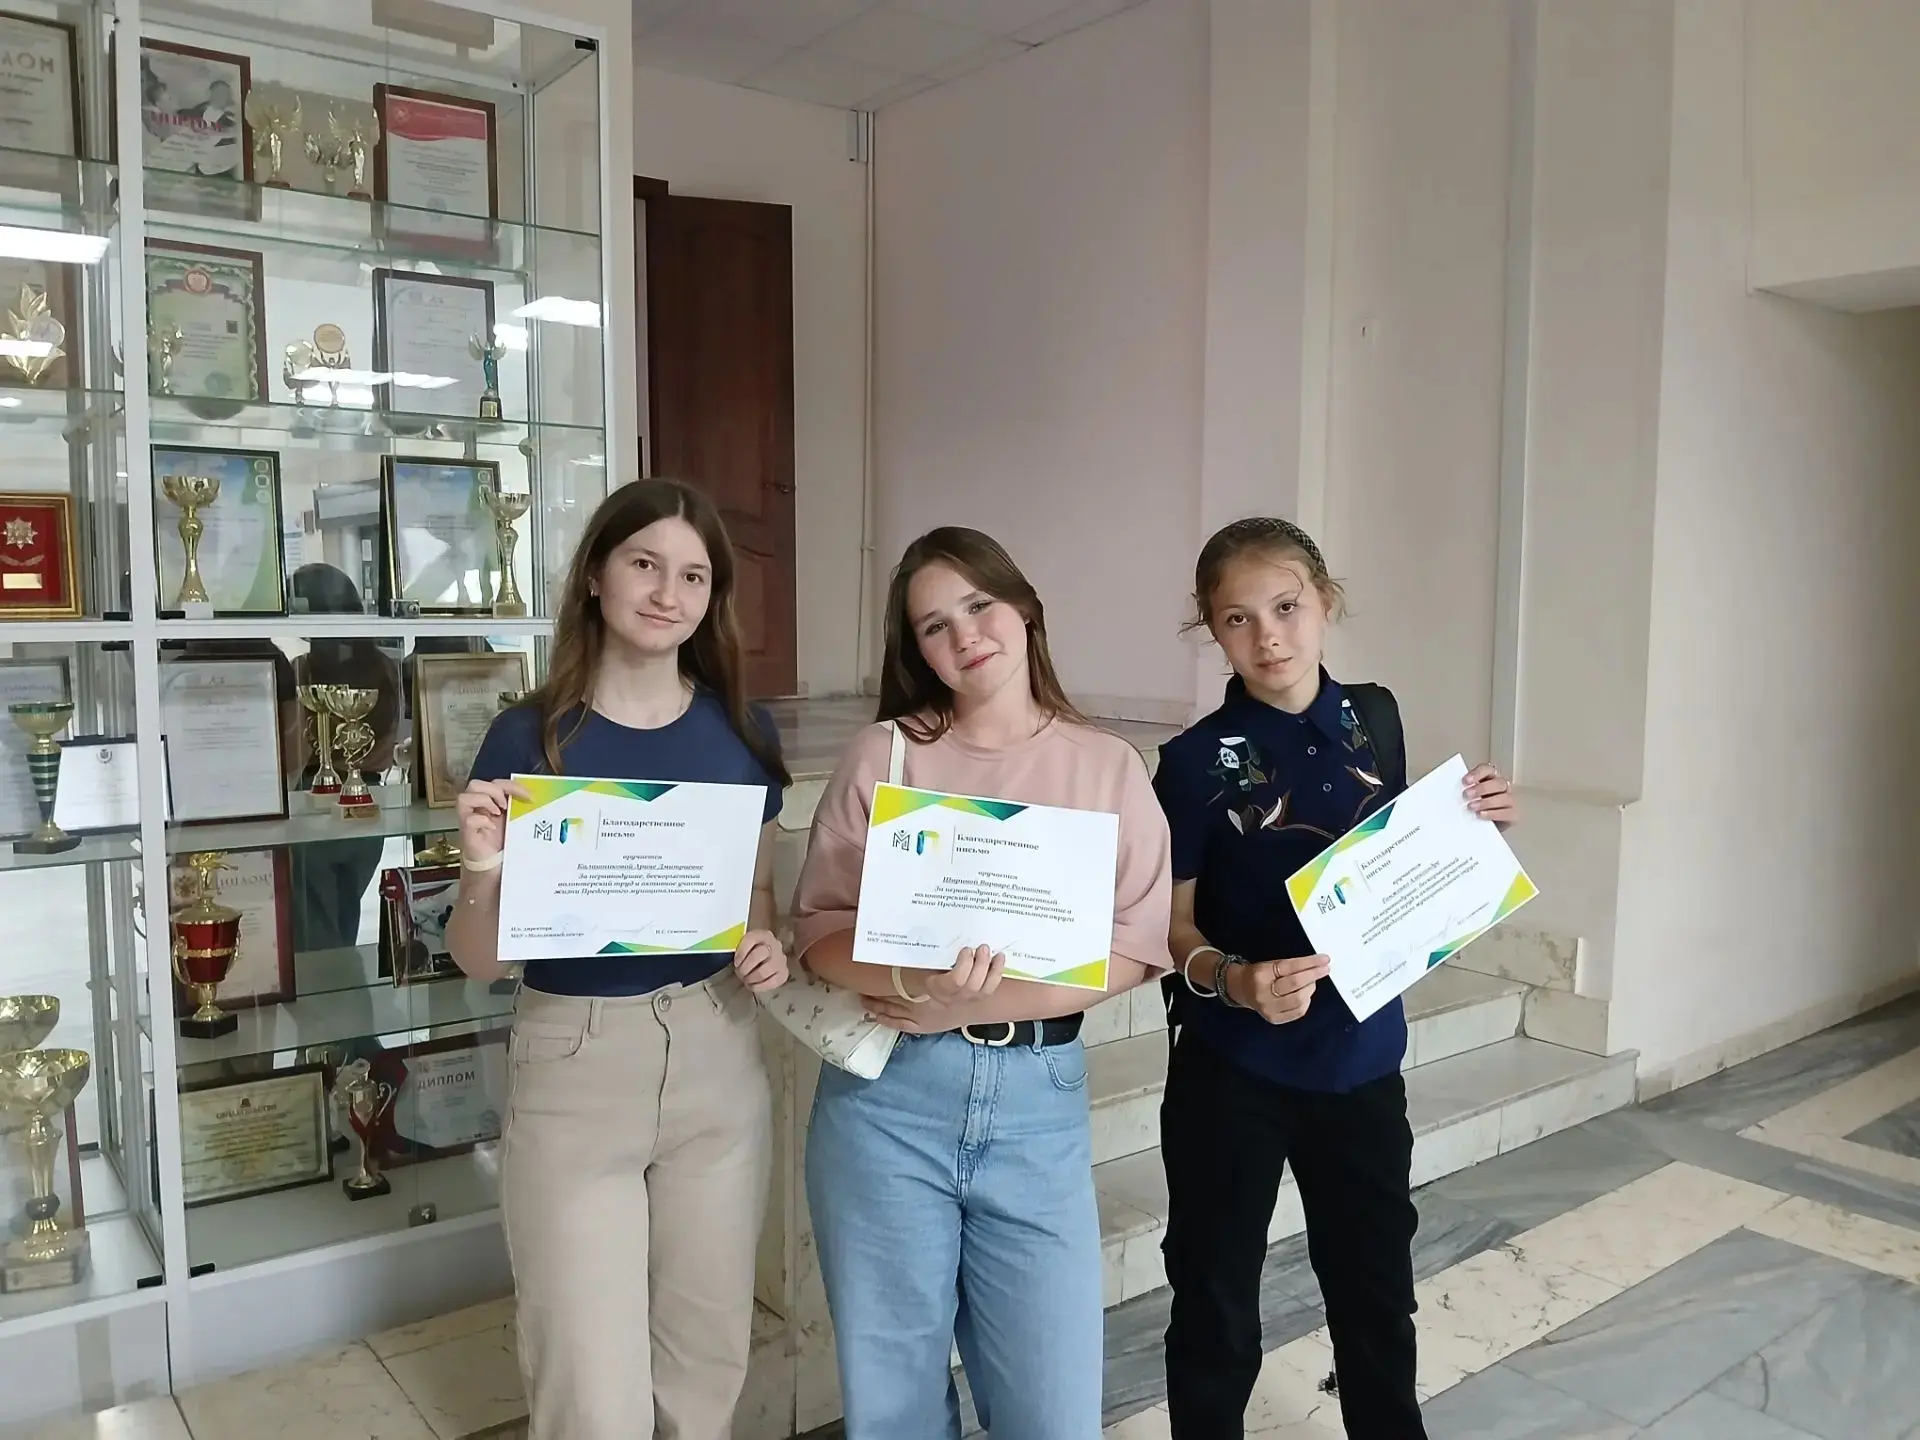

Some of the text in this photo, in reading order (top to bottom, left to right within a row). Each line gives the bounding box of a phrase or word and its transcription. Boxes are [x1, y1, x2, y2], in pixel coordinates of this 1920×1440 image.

[602, 818, 686, 829] Благодарственное
[601, 831, 636, 839] письмо
[957, 834, 1039, 851] Благодарственное
[956, 846, 990, 855] письмо
[1360, 825, 1421, 871] Благодарственное
[1365, 859, 1392, 880] письмо
[417, 1071, 475, 1090] ДИПЛОМ
